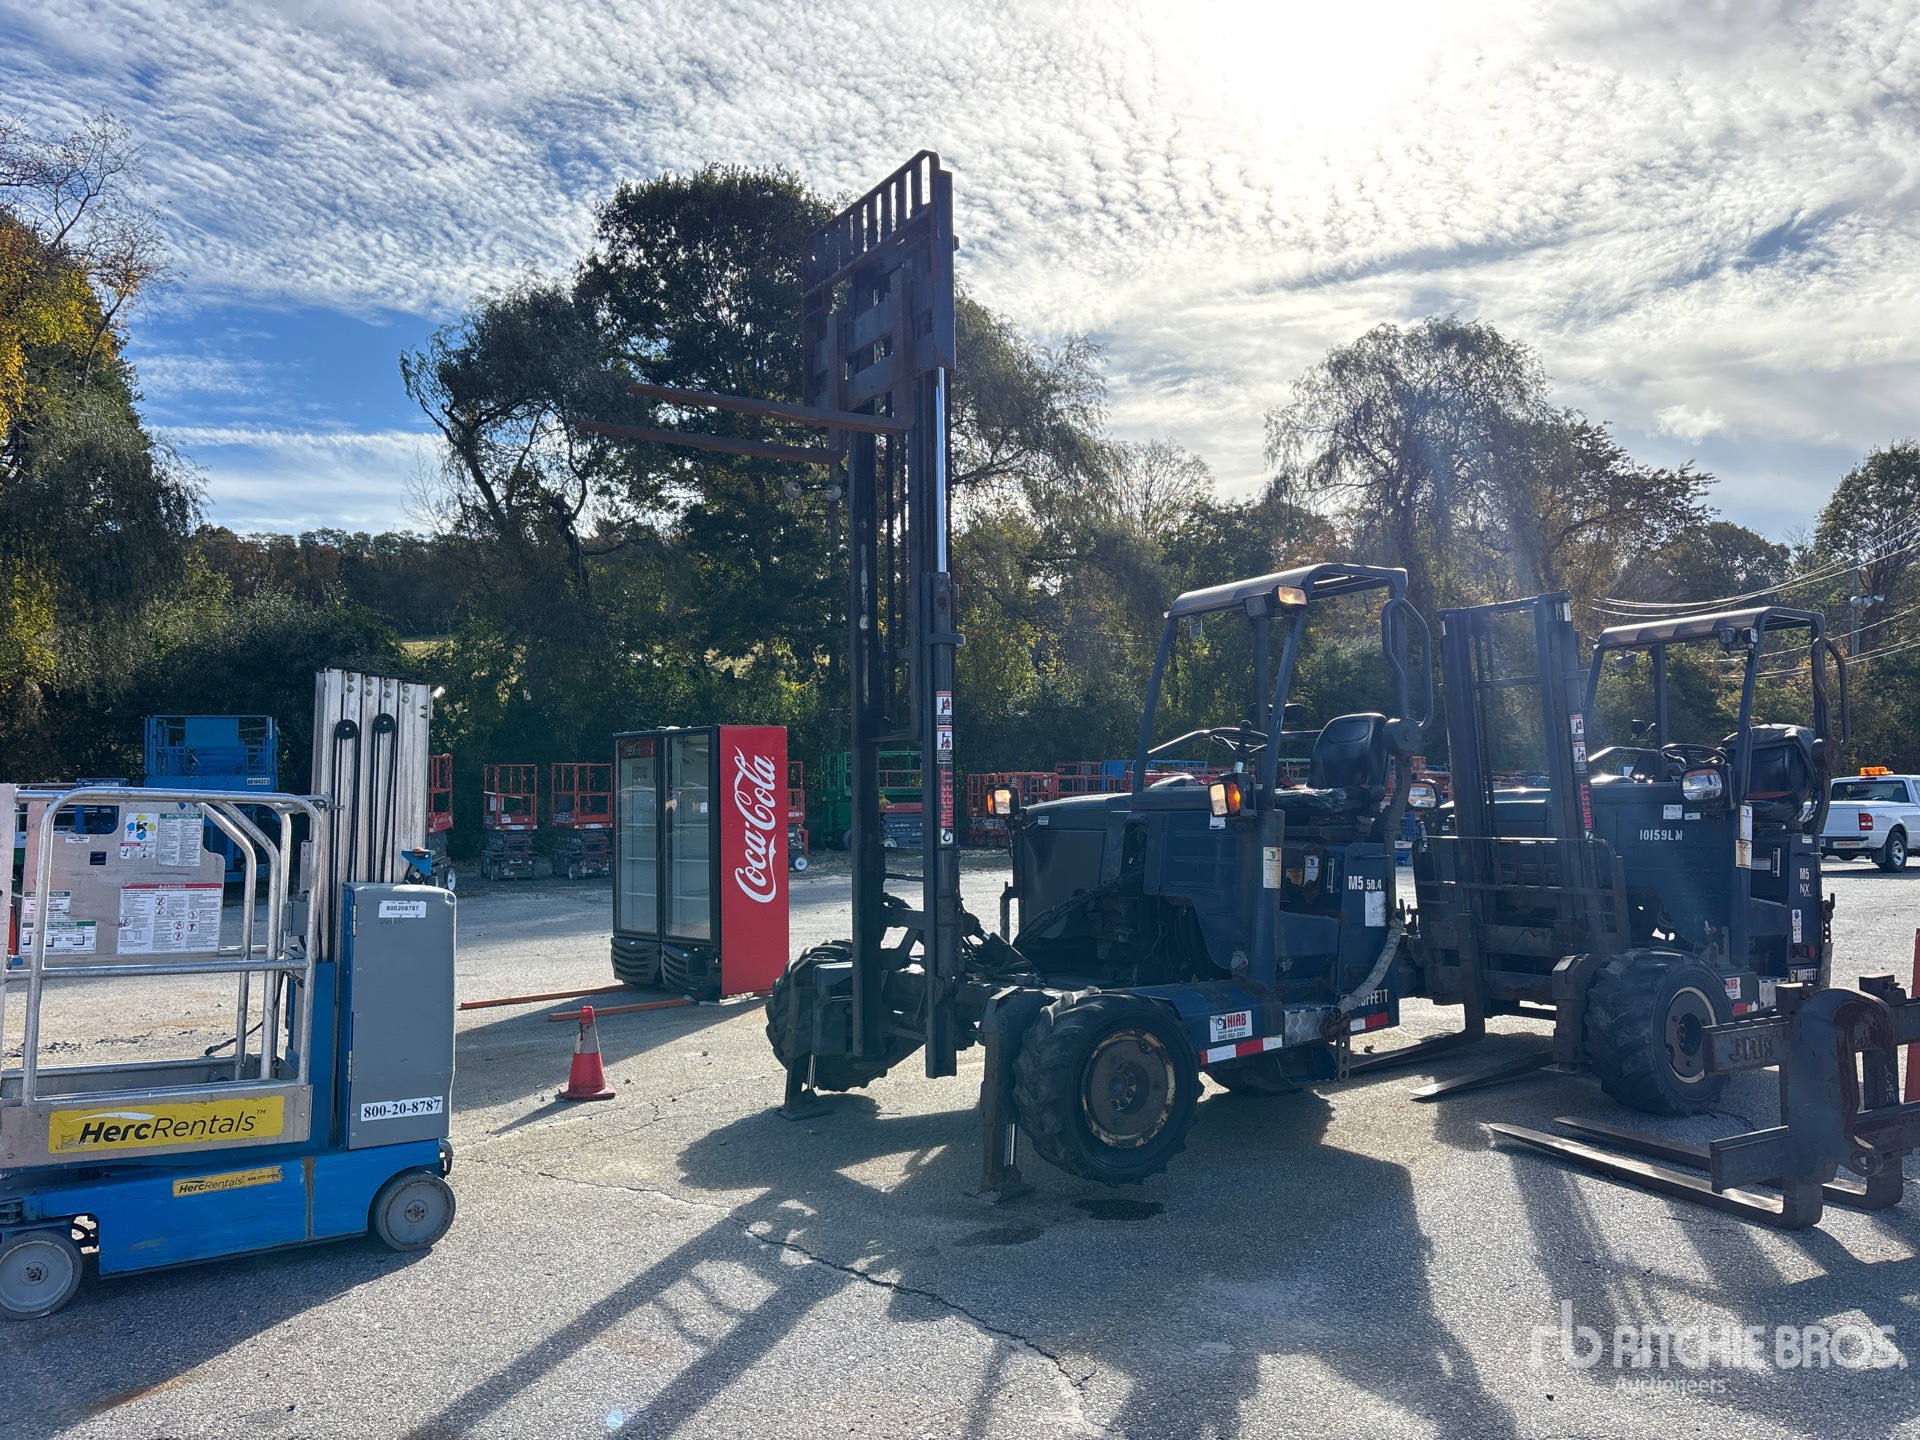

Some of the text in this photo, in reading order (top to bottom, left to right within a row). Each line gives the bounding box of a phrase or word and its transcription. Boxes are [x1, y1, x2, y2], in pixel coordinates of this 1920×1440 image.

[734, 745, 776, 903] Coca-Cola
[1800, 867, 1810, 880] M5
[1348, 875, 1382, 890] M5 50.4
[1227, 1012, 1247, 1029] HIAB
[363, 1099, 441, 1118] 800-20-8787
